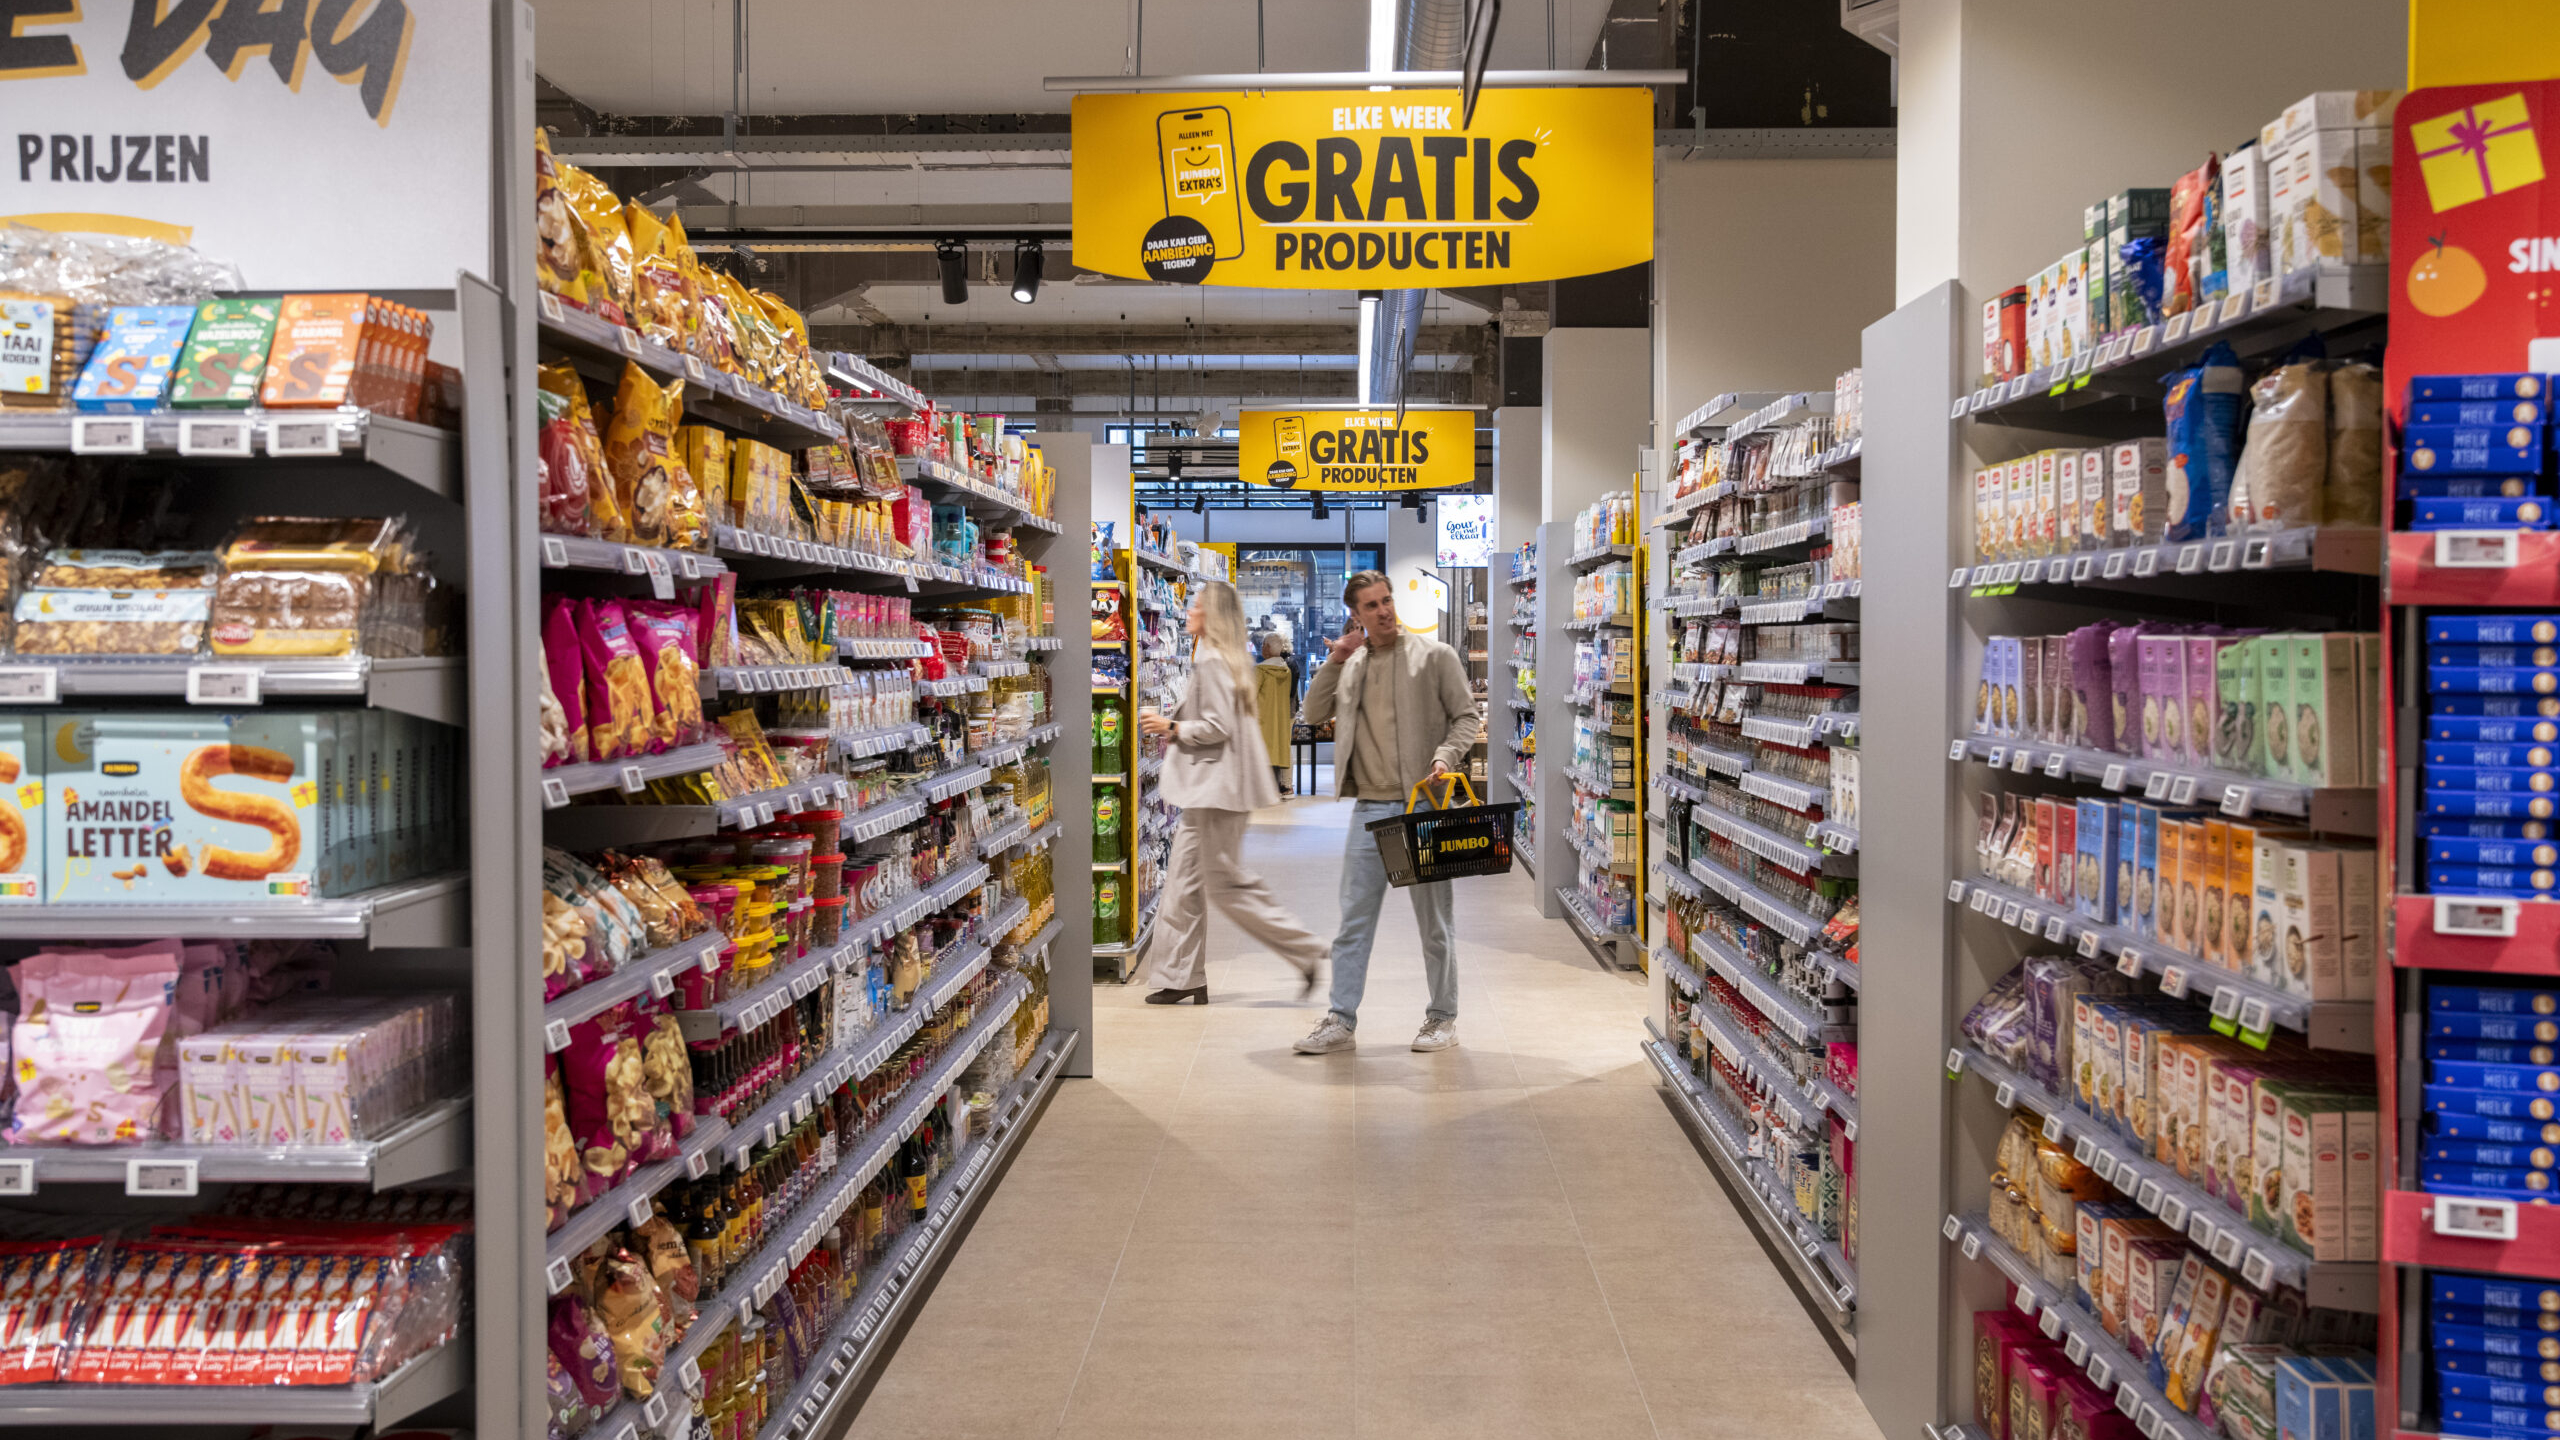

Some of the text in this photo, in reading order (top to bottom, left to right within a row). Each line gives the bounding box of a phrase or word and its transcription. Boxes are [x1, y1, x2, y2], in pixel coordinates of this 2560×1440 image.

[1333, 106, 1452, 131] ELKE WEEK
[1178, 130, 1214, 140] ALLEEN MET
[18, 134, 211, 183] PRIJZEN
[1180, 167, 1221, 180] JUMBO
[1245, 136, 1540, 224] GRATIS
[1179, 178, 1222, 191] EXTRA'S
[1147, 235, 1207, 251] DAAR KAN GEEN
[1275, 231, 1511, 271] PRODUCTEN
[1143, 243, 1214, 263] AANBIEDING
[2508, 237, 2560, 274] SIN
[1162, 258, 1196, 270] TEGENOP
[4, 336, 42, 352] TAAI
[1344, 417, 1366, 428] ELKE
[1310, 429, 1429, 464] GRATIS
[1321, 467, 1417, 484] PRODUCTEN
[2463, 509, 2500, 523] MELK
[2477, 626, 2515, 643] MELK
[66, 800, 174, 822] AMANDEL
[67, 827, 173, 858] LETTER
[1439, 836, 1490, 853] JUMBO
[233, 1361, 253, 1371] Loll
